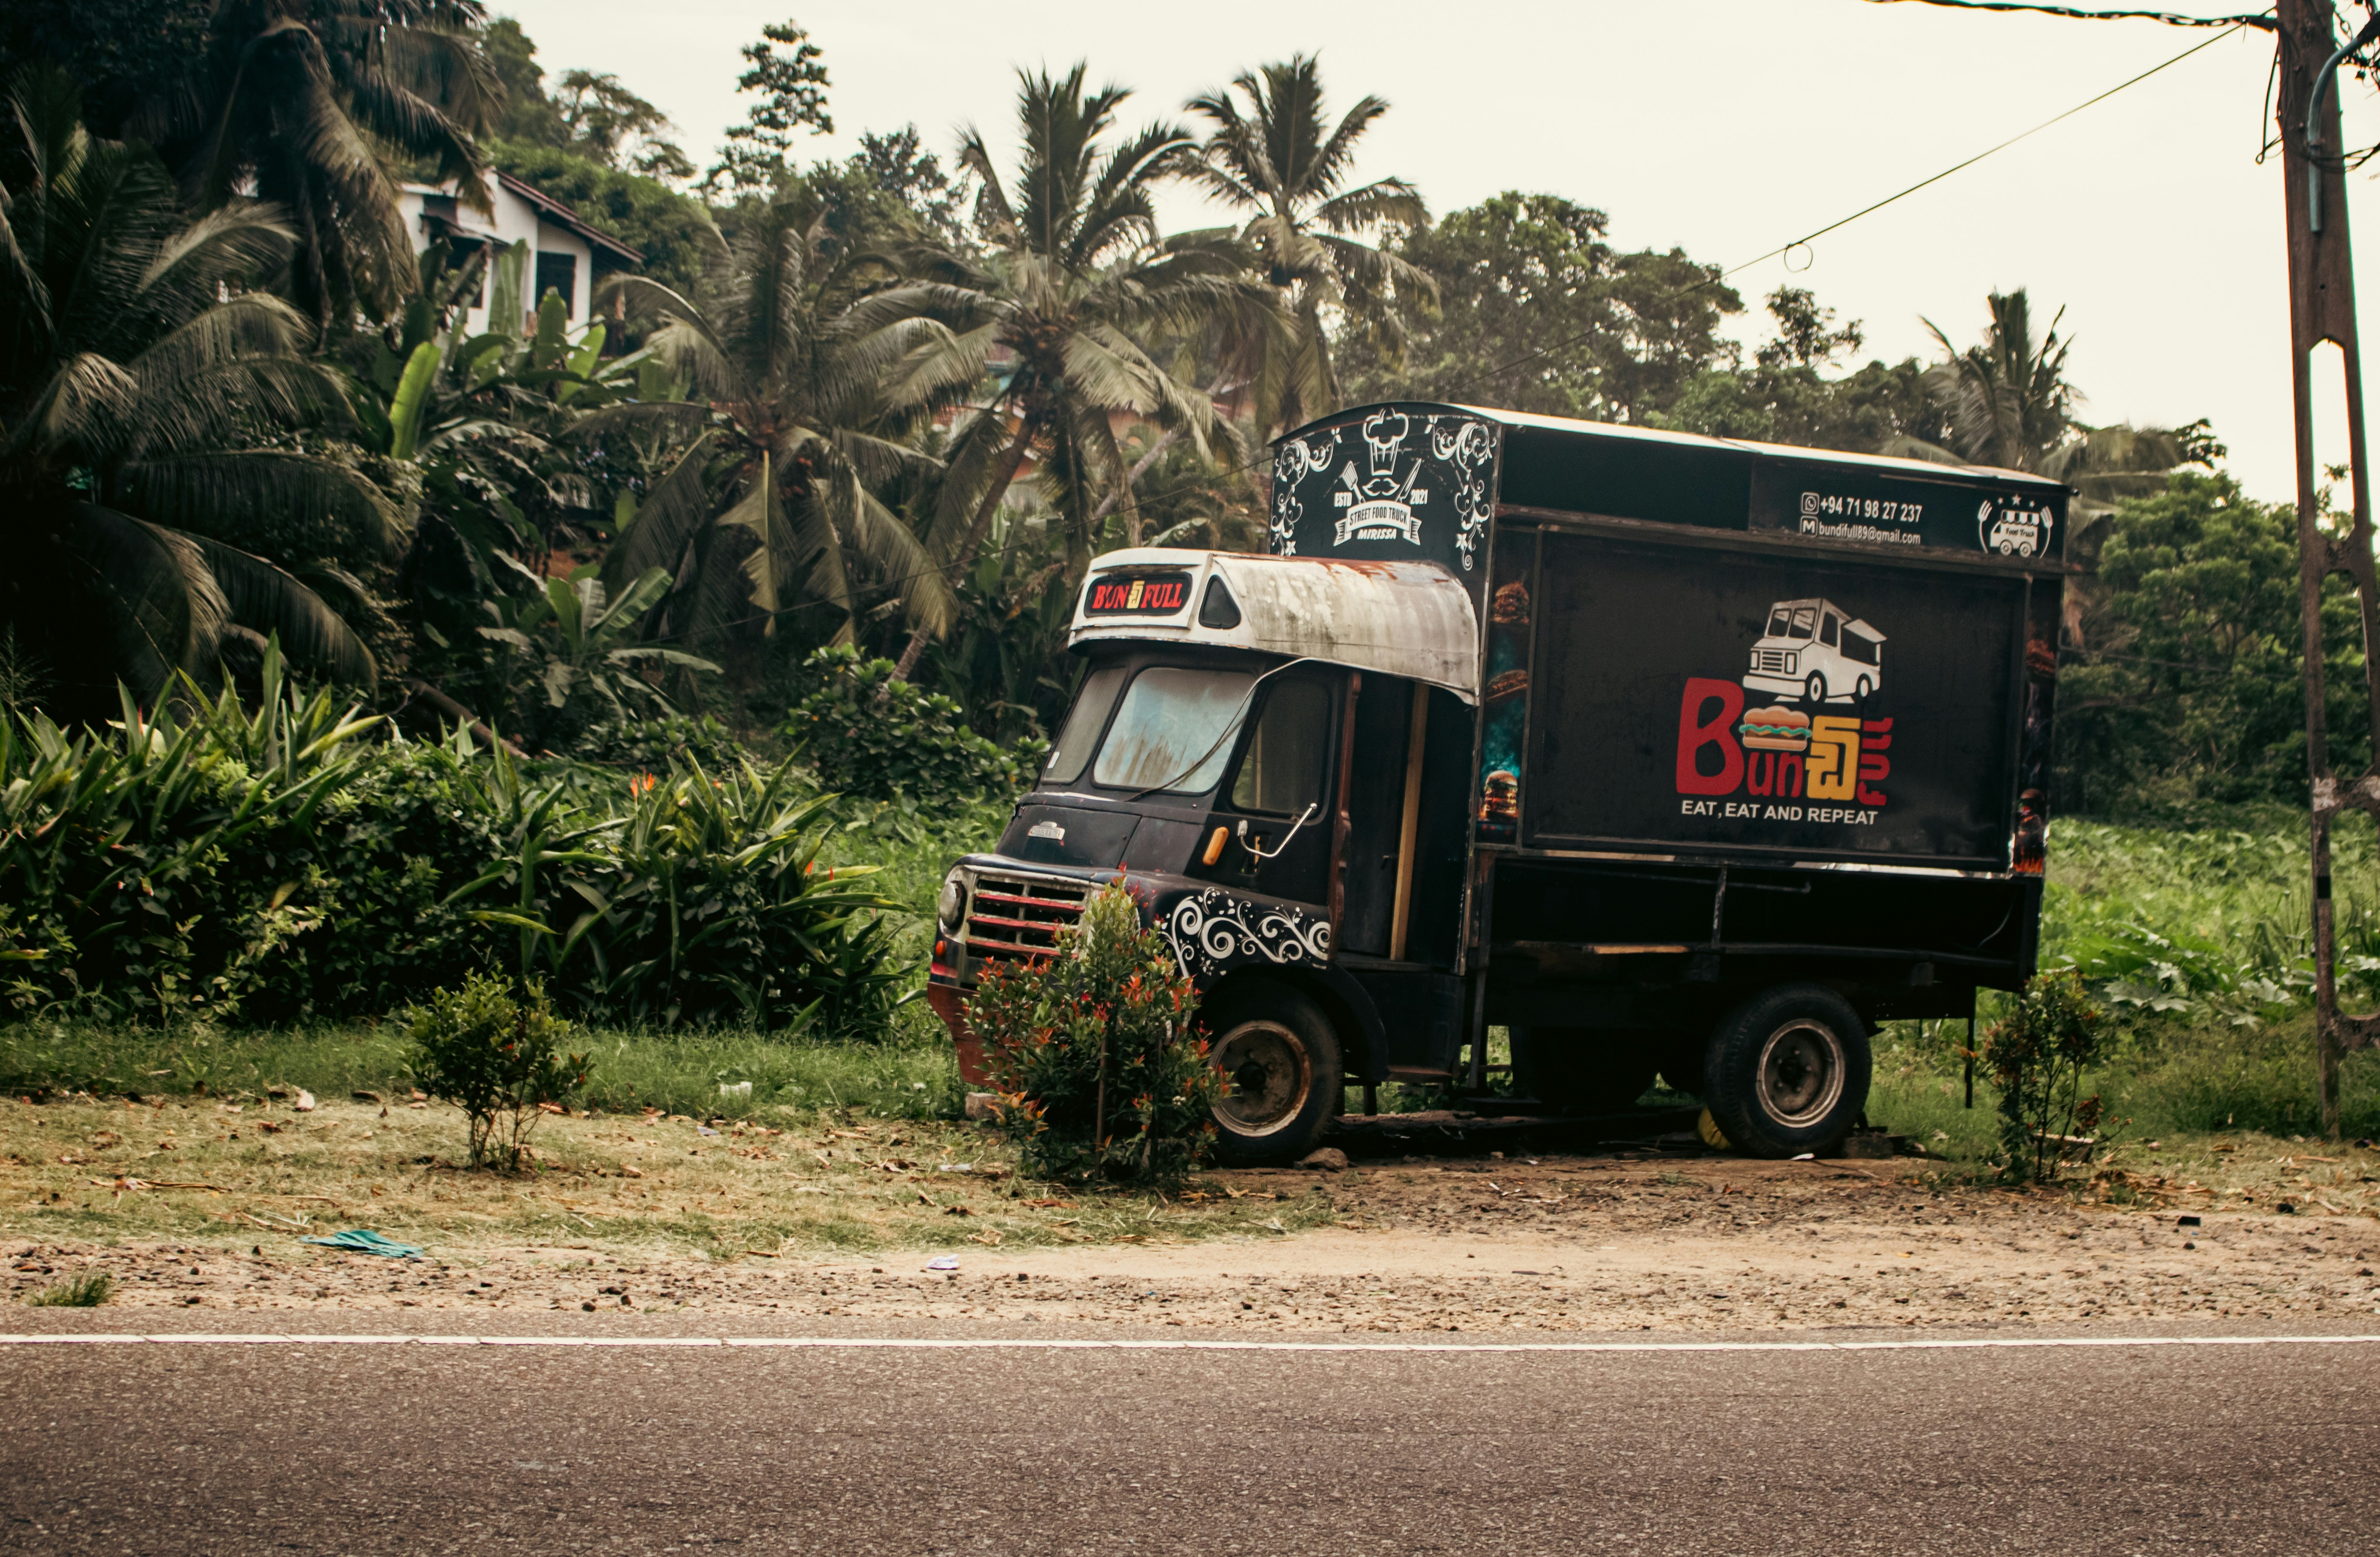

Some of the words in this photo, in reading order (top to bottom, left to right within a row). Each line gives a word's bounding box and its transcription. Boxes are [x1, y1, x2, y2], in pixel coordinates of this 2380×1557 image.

[1334, 492, 1352, 507] ESTD
[1410, 489, 1428, 504] 2021
[1350, 508, 1371, 525] STREET
[1373, 506, 1387, 518] FOOD
[1389, 507, 1407, 525] TRUCK
[1821, 496, 1842, 514] +94
[1847, 497, 1860, 516] 71
[1865, 499, 1879, 518] 98
[1882, 502, 1897, 520] 27
[1900, 503, 1922, 523] 237
[1357, 528, 1397, 540] MIRISSA
[1819, 522, 1921, 544] bundifull89@gmail.com
[1092, 585, 1130, 609] BUN
[1140, 583, 1183, 608] FULL
[1725, 803, 1760, 818] EAT
[1764, 805, 1802, 821] AND
[1807, 808, 1878, 825] REPEAT
